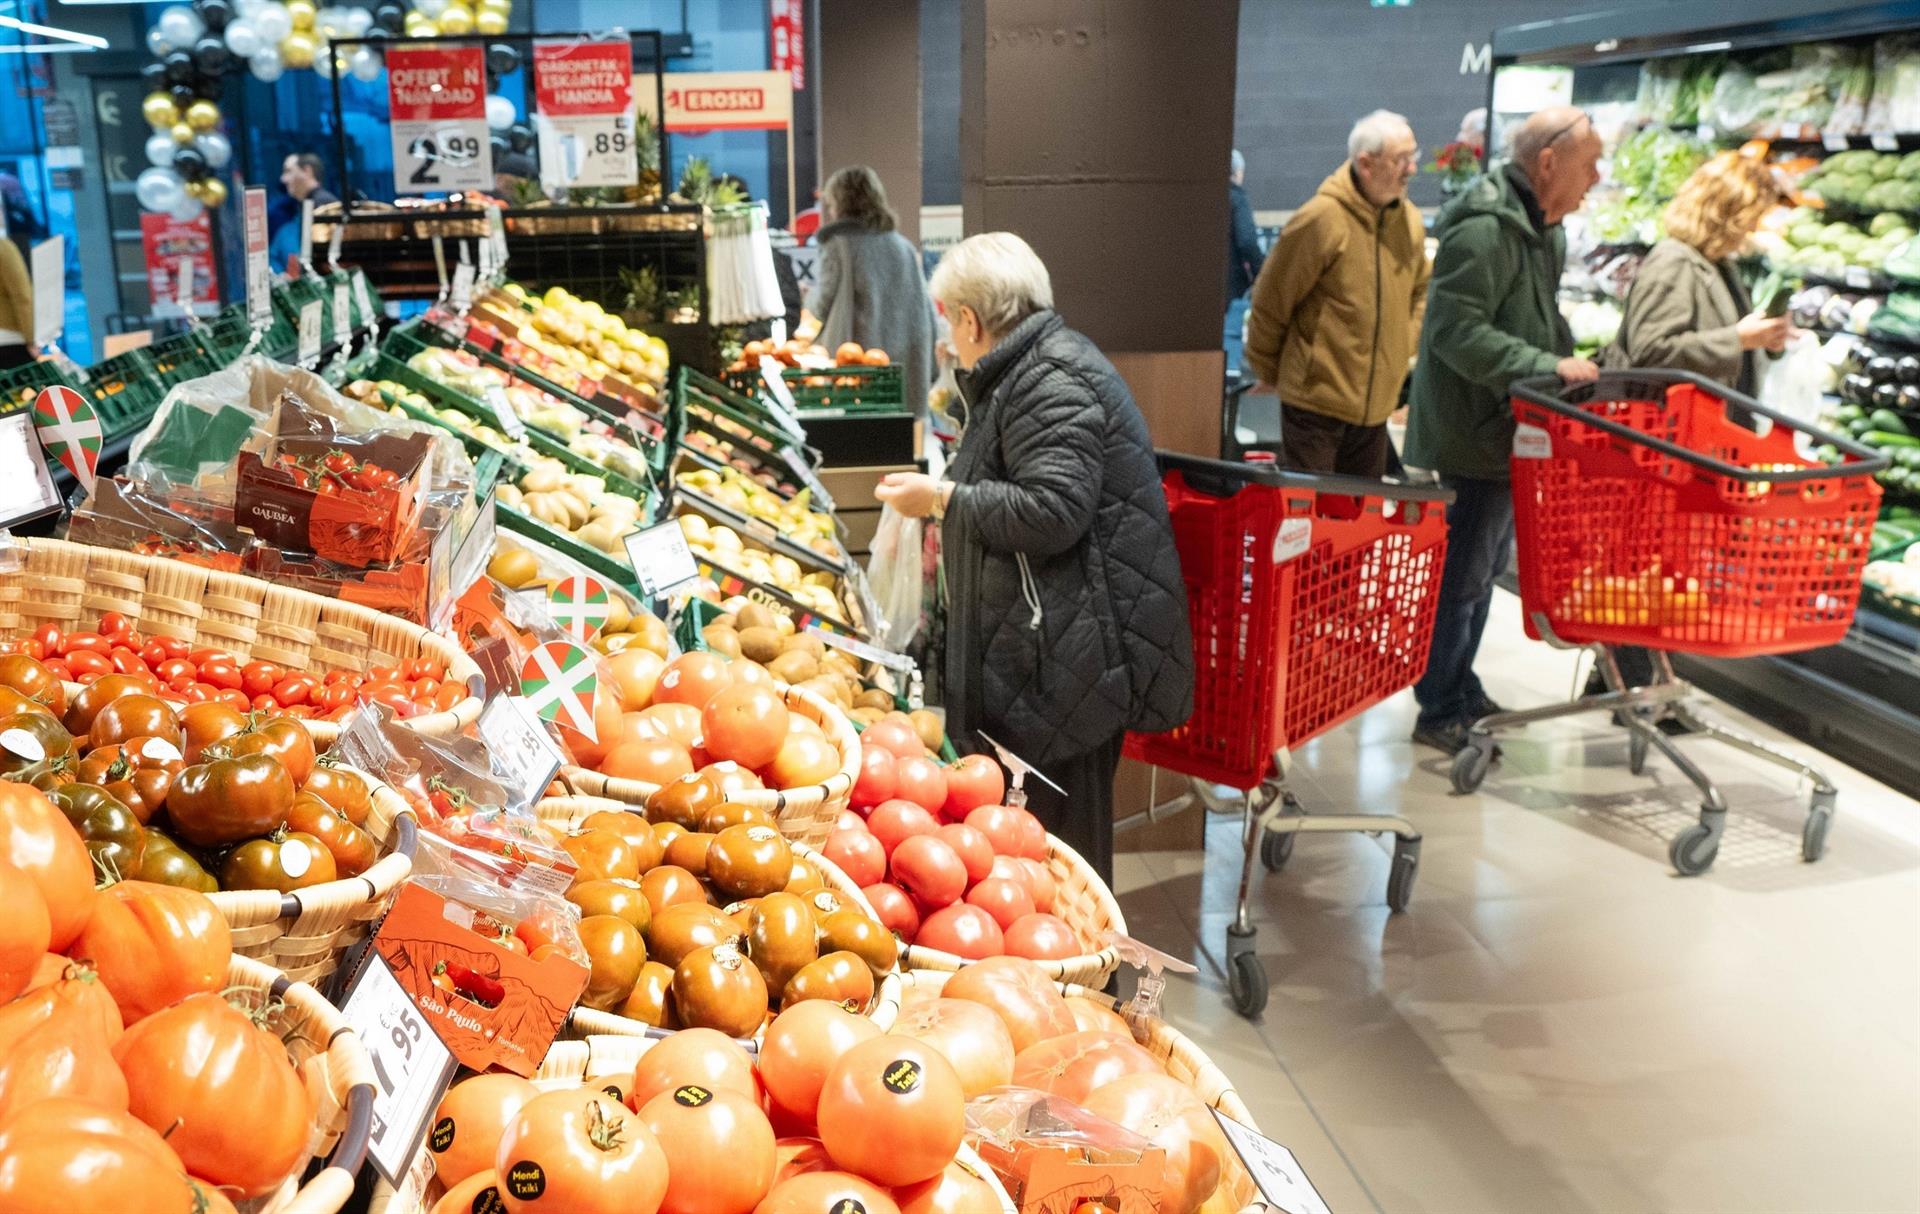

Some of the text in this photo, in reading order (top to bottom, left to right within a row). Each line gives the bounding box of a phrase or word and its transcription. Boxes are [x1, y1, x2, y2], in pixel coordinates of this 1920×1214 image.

[391, 68, 479, 87] OFERTN
[554, 87, 616, 104] HANDIA
[688, 91, 760, 109] EROSKI
[446, 1007, 482, 1033] Paulo
[886, 1060, 912, 1085] Mendi
[434, 1121, 452, 1139] Mendi
[435, 1132, 451, 1148] Txiki
[512, 1169, 540, 1181] Mendi
[515, 1182, 539, 1194] Txiki
